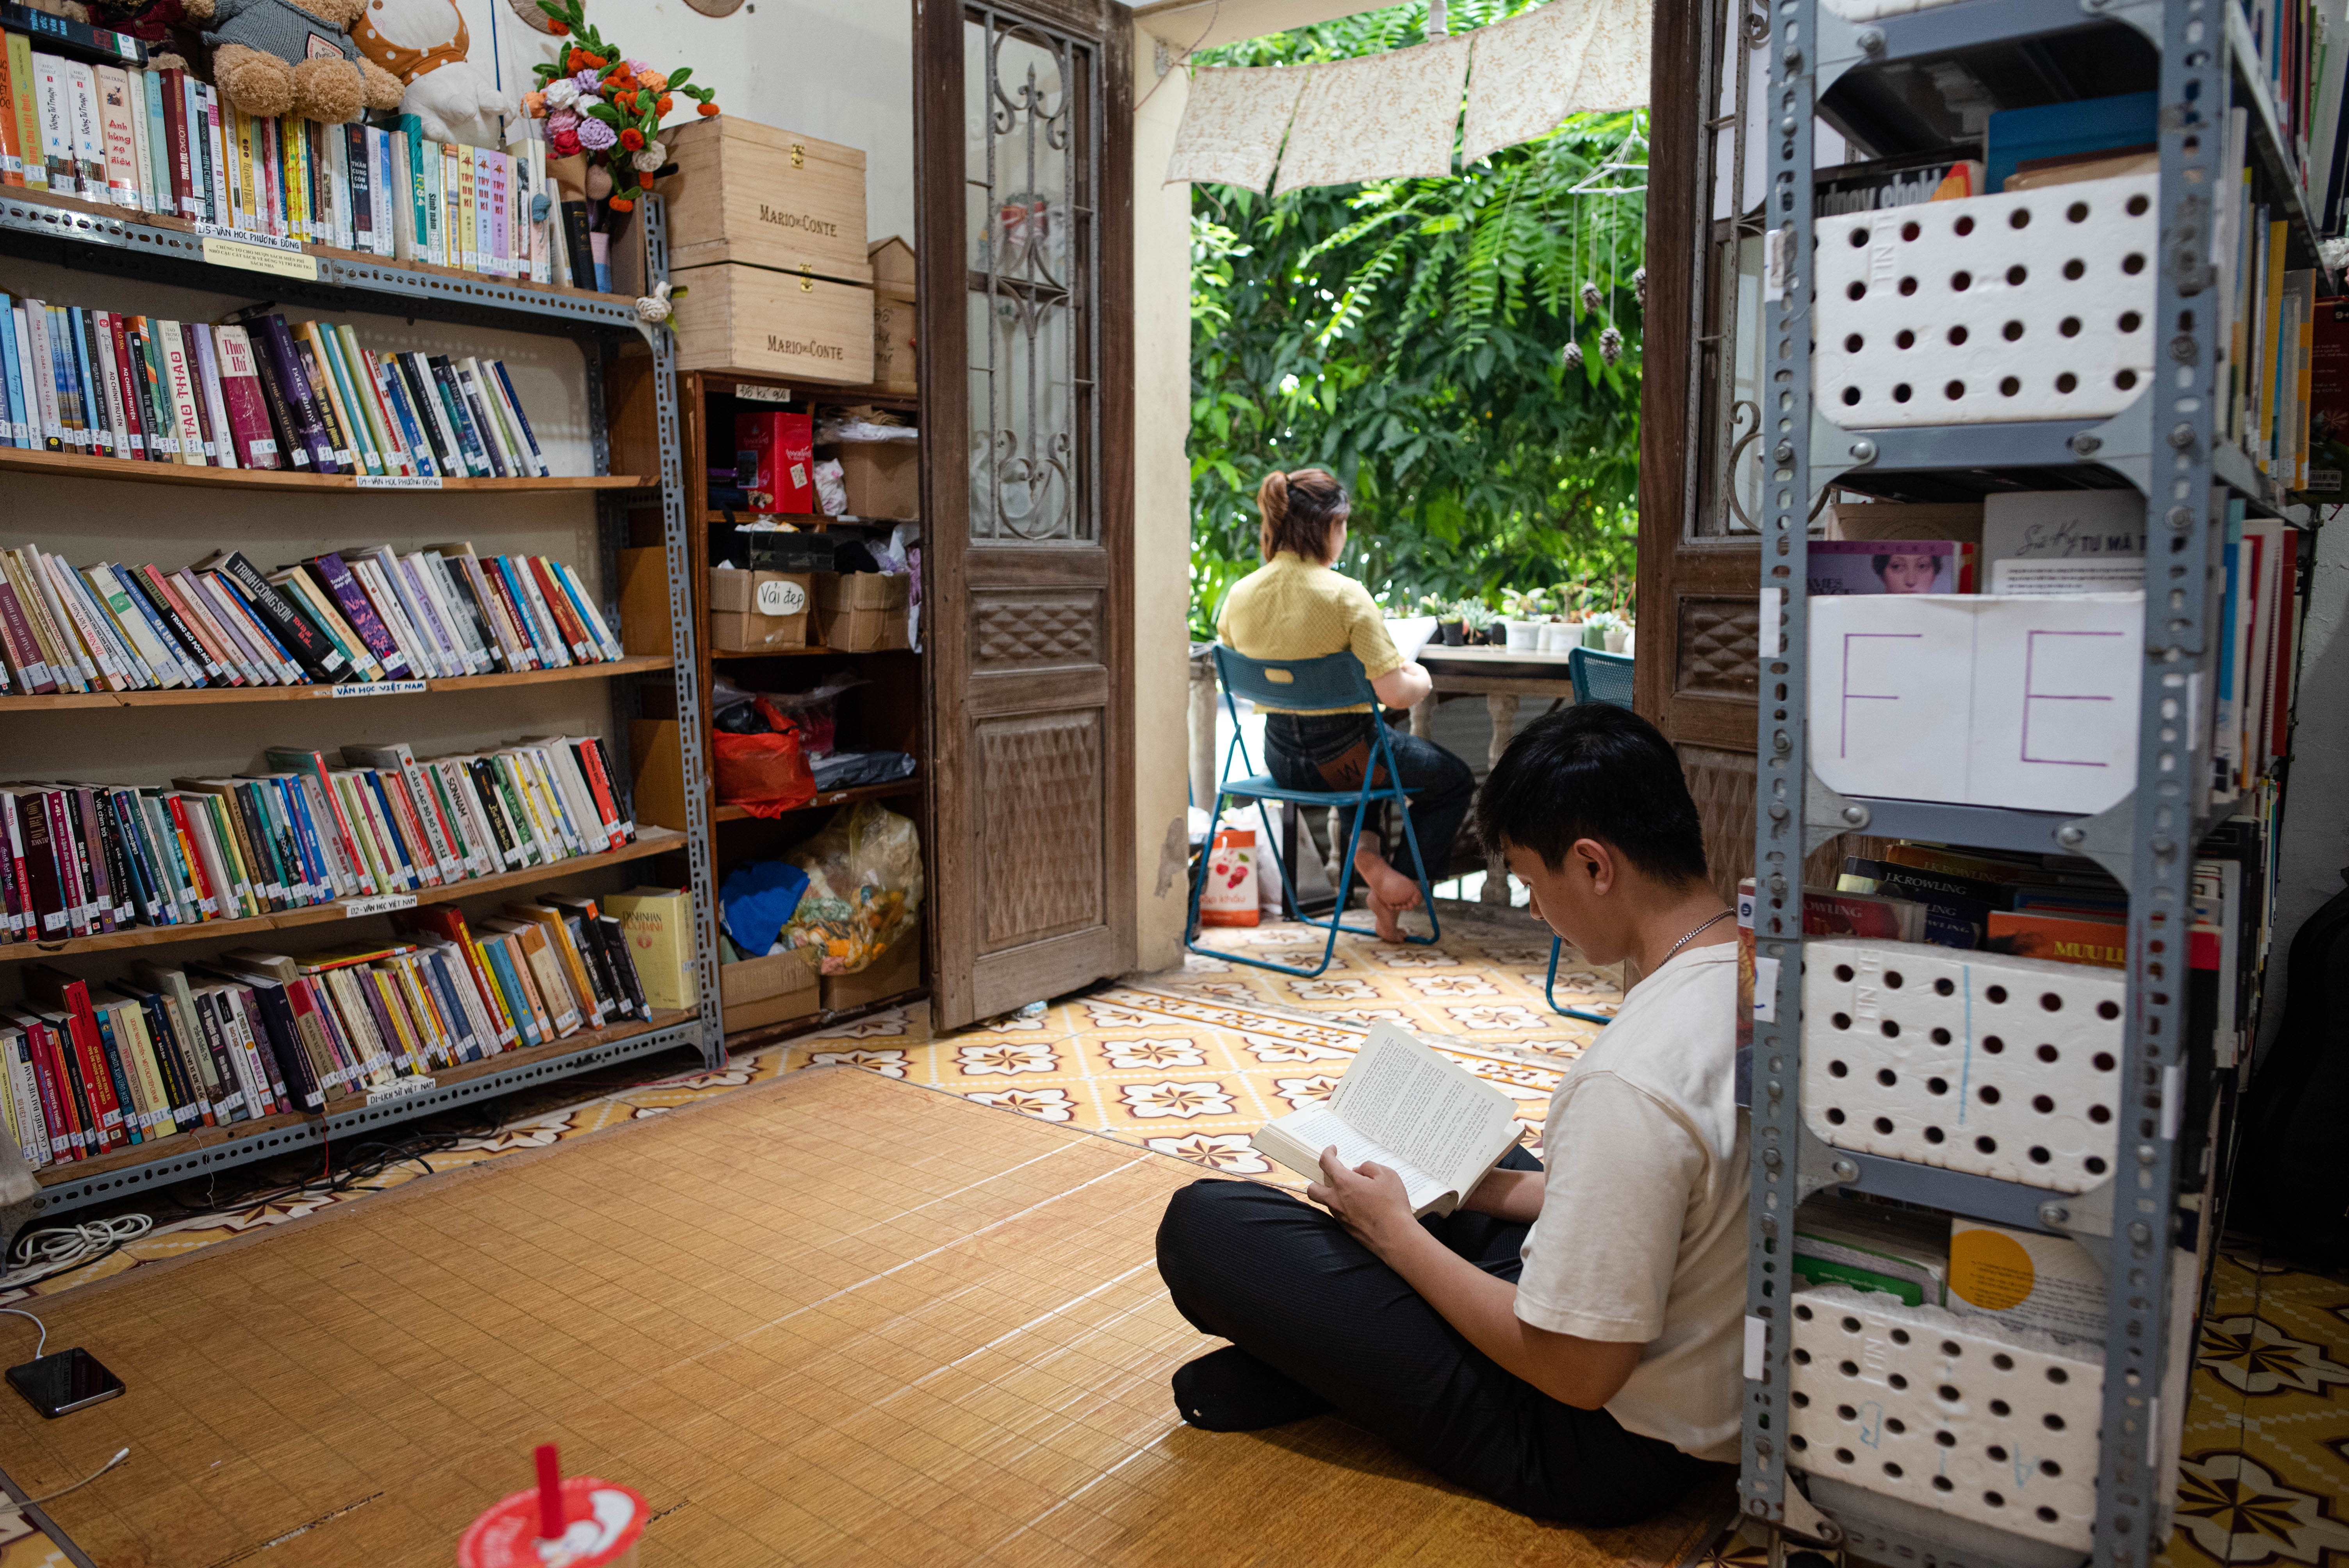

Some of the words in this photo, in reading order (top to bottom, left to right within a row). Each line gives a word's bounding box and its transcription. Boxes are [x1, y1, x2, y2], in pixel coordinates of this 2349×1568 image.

[315, 37, 330, 48] Limited
[330, 46, 342, 55] Edition
[47, 87, 56, 105] Truyện
[49, 113, 59, 130] Khổng
[109, 119, 127, 130] Anh
[108, 132, 130, 144] hùng
[111, 156, 130, 166] điêu
[180, 152, 188, 162] TÂY
[181, 164, 189, 180] TẠNG
[461, 173, 473, 183] TÂY
[478, 176, 490, 186] TÂY
[493, 180, 504, 190] TÂY
[413, 173, 425, 207] 1Q84
[462, 187, 472, 196] DU
[479, 189, 488, 198] DU
[494, 194, 504, 203] DU
[759, 204, 795, 228] MARIO
[803, 214, 837, 237] CONTE
[234, 231, 247, 241] HỌC
[250, 233, 277, 245] PHƯƠNG
[281, 237, 299, 249] ĐÔNG
[223, 338, 246, 356] Thủy
[768, 335, 802, 354] MARIO
[809, 340, 843, 360] CONTE
[123, 367, 128, 376] AQ
[109, 371, 115, 380] AQ
[114, 403, 123, 426] TRUYỆN
[757, 385, 769, 399] kí
[234, 560, 259, 586] TRỊNH
[254, 582, 278, 606] CÔNG
[273, 601, 293, 622] SƠN
[761, 582, 781, 604] Vải
[783, 588, 804, 609] đẹp
[3, 596, 14, 613] MINH
[71, 602, 82, 617] Nam
[9, 614, 20, 625] CHÍ
[78, 617, 87, 630] Việt
[152, 619, 164, 632] Tố
[16, 627, 25, 636] HỒ
[86, 630, 96, 646] Nhân
[162, 630, 176, 647] Tất
[171, 612, 187, 632] TRÚNG
[185, 631, 194, 641] SỐ
[191, 641, 203, 653] ĐỘC
[21, 637, 30, 650] VĂN
[93, 643, 103, 657] Thi
[337, 684, 355, 695] VĂN
[358, 686, 375, 696] HỌC
[379, 682, 401, 693] VIỆT
[1841, 633, 1922, 758] F
[2021, 629, 2124, 768] E
[447, 777, 459, 796] SƠN
[454, 795, 467, 817] NAM
[410, 770, 420, 787] CÂU
[417, 788, 426, 804] LẠC
[423, 805, 431, 816] BỘ
[428, 818, 435, 828] SỐ
[436, 839, 443, 848] DI
[140, 821, 148, 839] THẠCH
[110, 1051, 119, 1067] NGHÌN
[24, 1066, 33, 1082] NAM
[114, 1067, 122, 1080] XƯA
[49, 1089, 57, 1108] TRUYỀN
[121, 1091, 129, 1105] HIẾN
[34, 1113, 43, 1131] TRIỀU
[39, 1133, 47, 1147] CÁC
